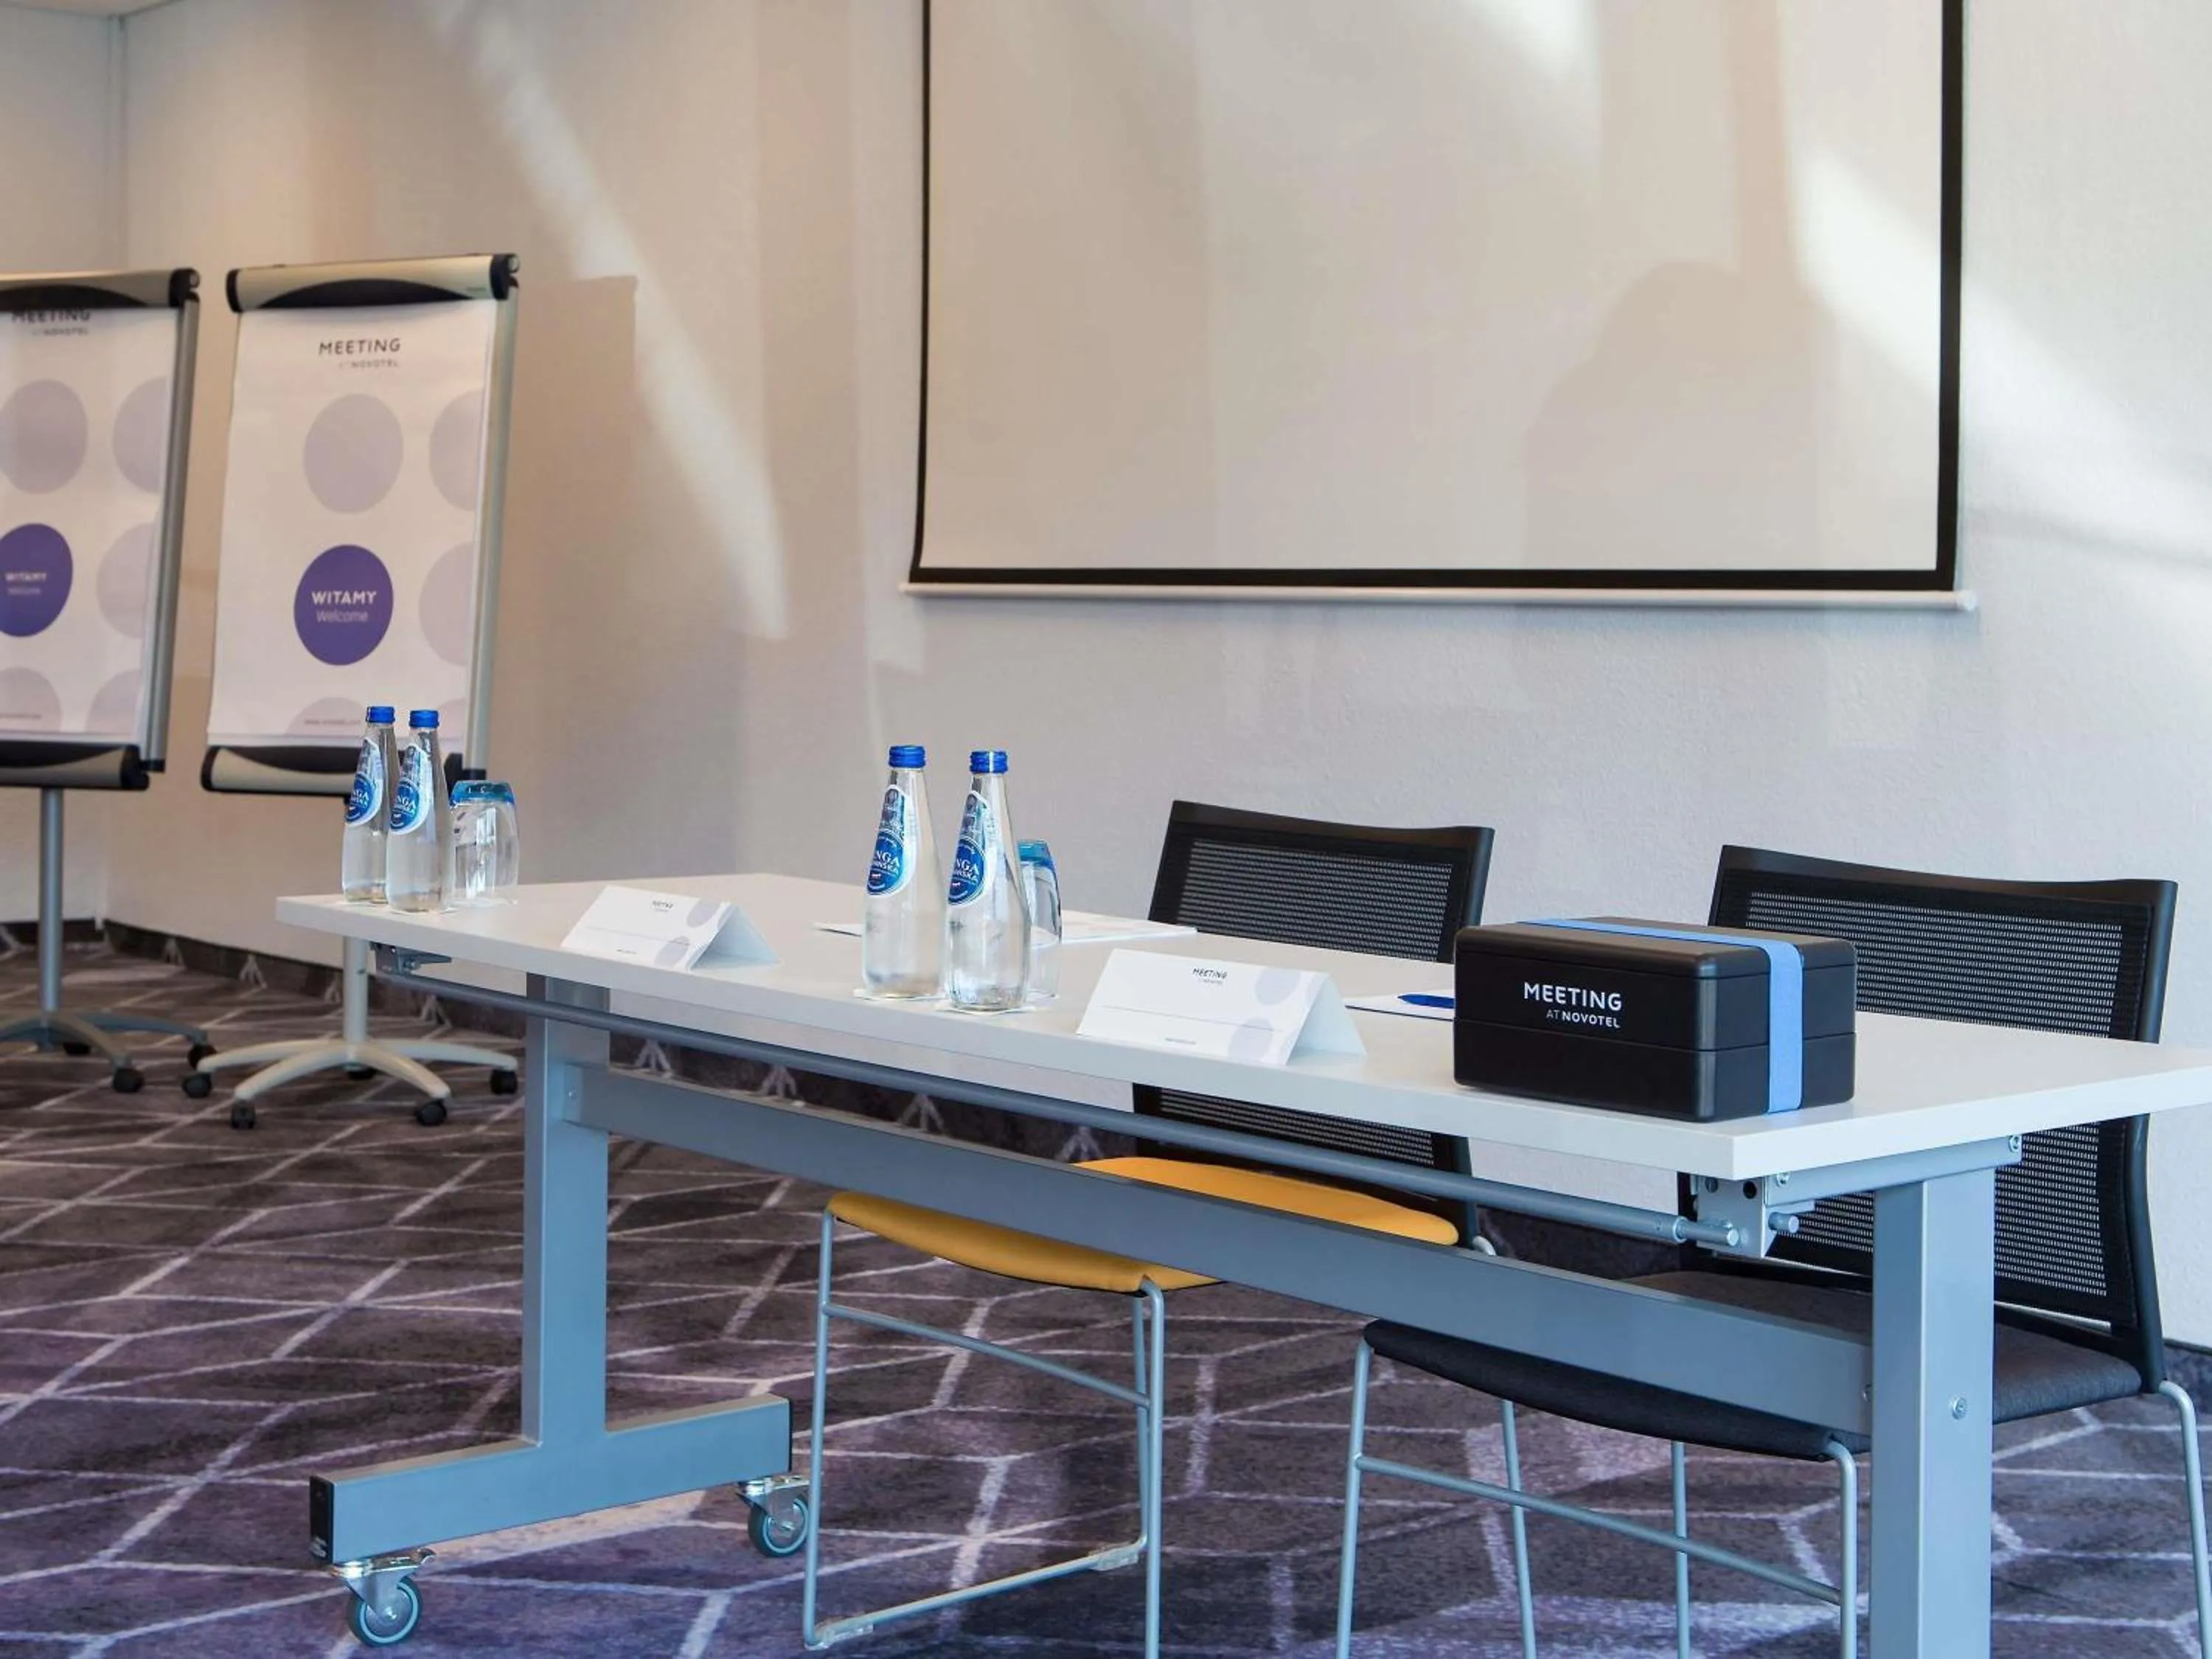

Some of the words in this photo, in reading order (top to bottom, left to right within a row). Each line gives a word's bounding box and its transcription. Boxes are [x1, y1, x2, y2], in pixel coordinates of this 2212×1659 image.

[318, 338, 401, 356] MEETING
[311, 590, 378, 605] WITAMY
[874, 849, 900, 869] NGA
[956, 858, 980, 876] NGA
[1192, 967, 1228, 979] MEETING
[1523, 981, 1622, 1012] MEETING
[1546, 1009, 1561, 1020] AT
[1562, 1011, 1621, 1029] NOVOTEL
